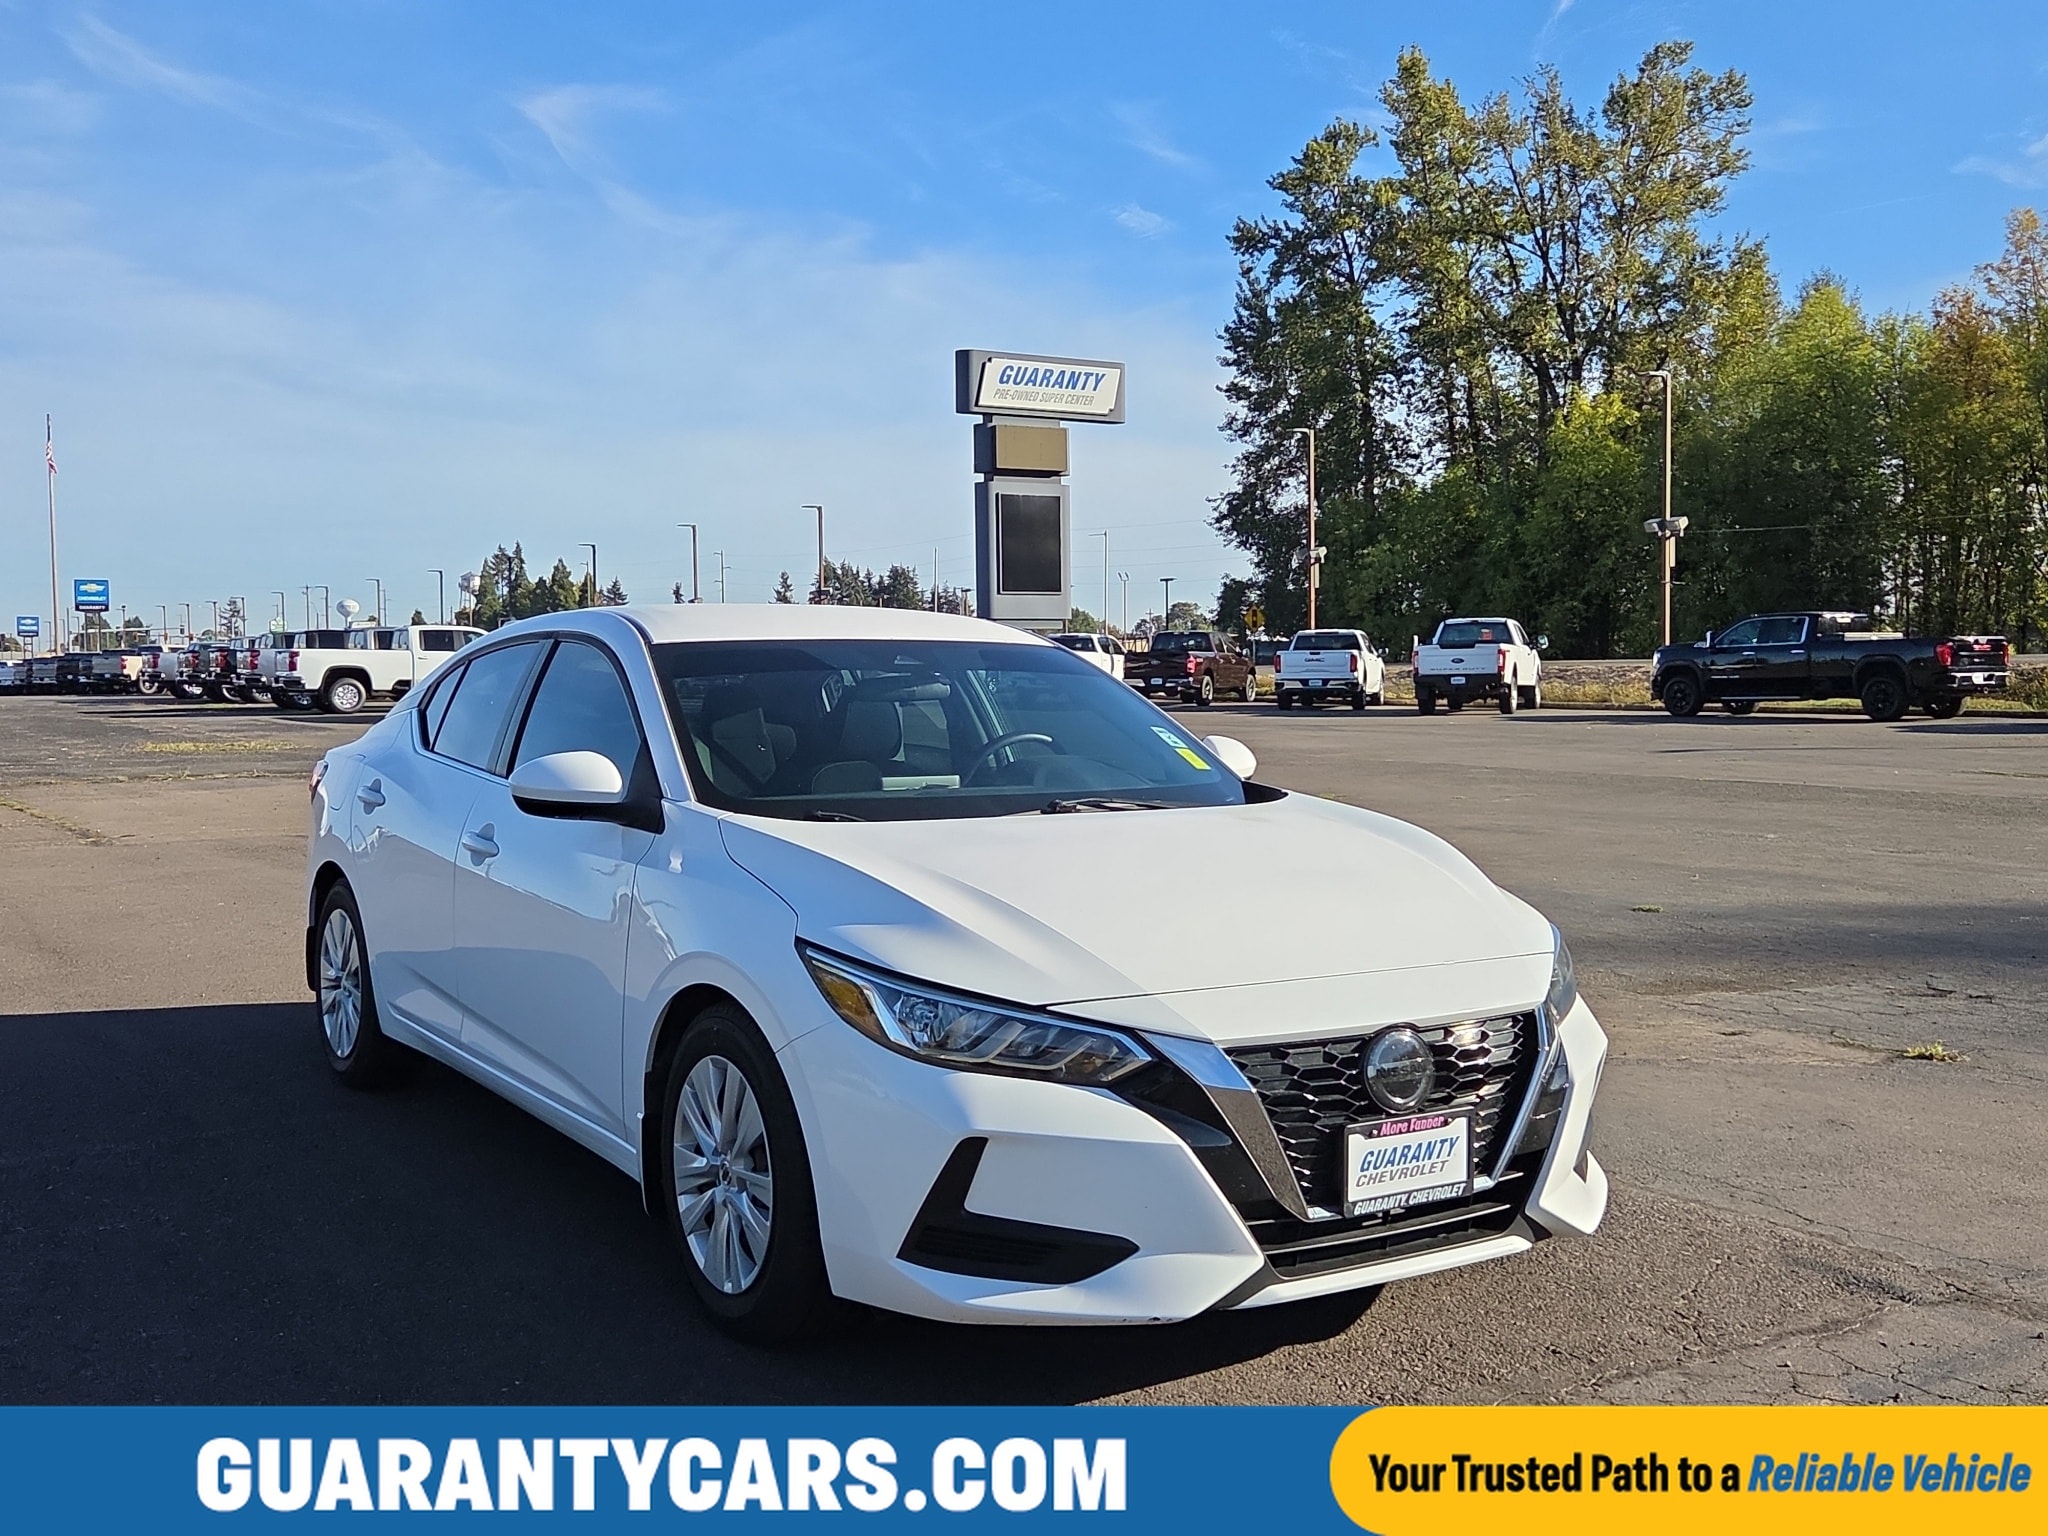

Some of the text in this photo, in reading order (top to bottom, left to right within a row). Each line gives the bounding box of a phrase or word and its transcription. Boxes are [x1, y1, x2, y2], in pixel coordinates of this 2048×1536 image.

[998, 365, 1106, 392] GUARANTY
[993, 388, 1095, 407] PRE-OWNED SUPER CENTER
[1376, 1062, 1426, 1079] NISSAN
[1380, 1121, 1408, 1136] More
[1360, 1136, 1460, 1173] GUARANTY
[1356, 1160, 1449, 1188] CHEVROLET
[1354, 1183, 1467, 1216] GUARANTY CHEVROLET
